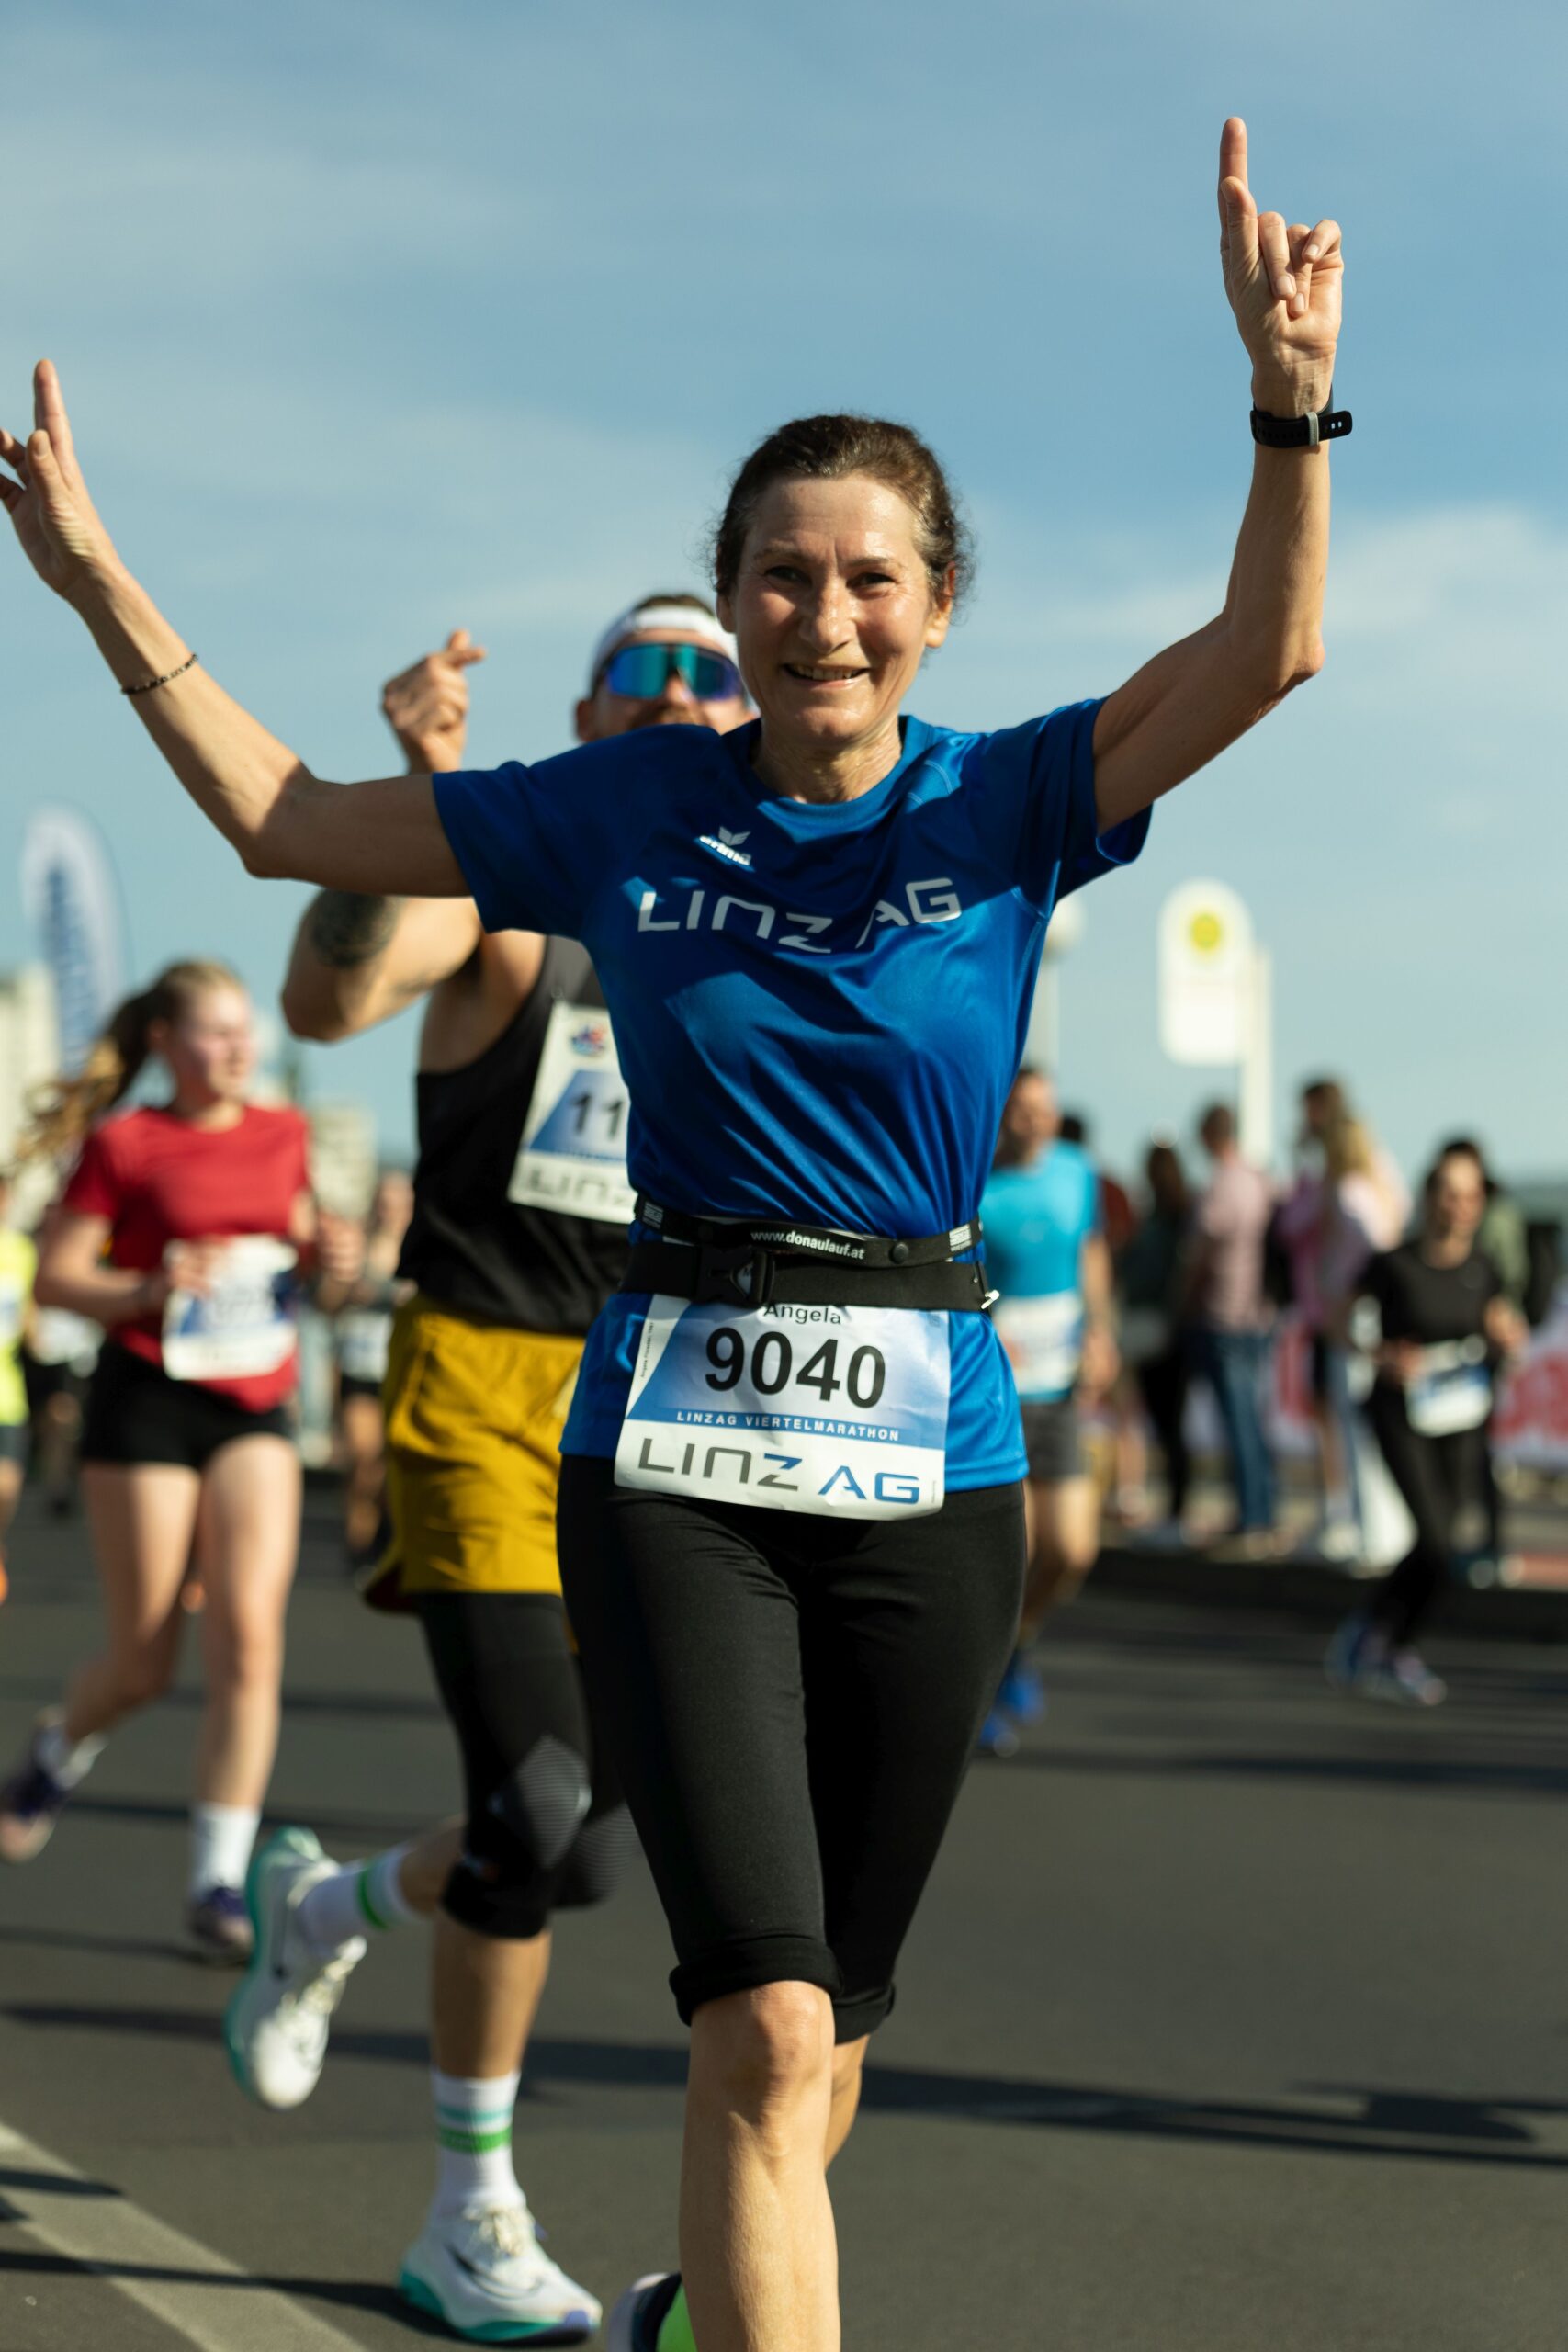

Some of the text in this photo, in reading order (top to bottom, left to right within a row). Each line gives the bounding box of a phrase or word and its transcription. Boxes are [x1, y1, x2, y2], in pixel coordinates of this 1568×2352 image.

[637, 877, 963, 954] LINZ AG
[750, 1230, 865, 1260] www.donaulauf.at
[764, 1303, 841, 1325] Angela
[705, 1327, 886, 1409] 9040
[745, 1415, 900, 1442] VIERTELMARATHON
[638, 1438, 803, 1492] LINZ
[818, 1465, 919, 1505] AG
